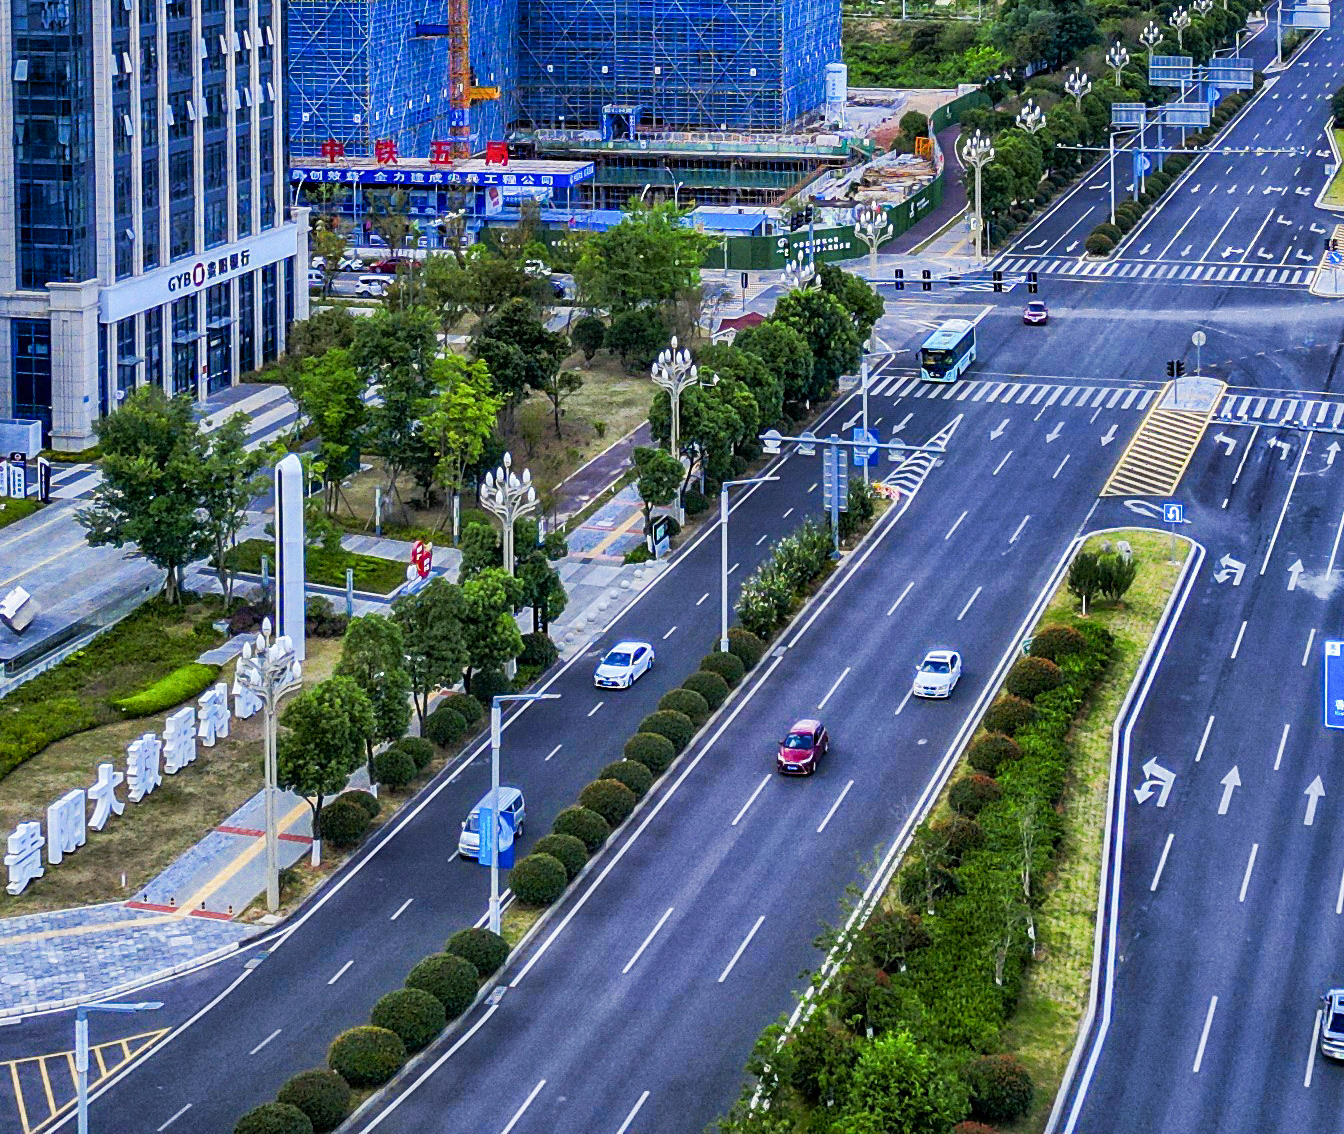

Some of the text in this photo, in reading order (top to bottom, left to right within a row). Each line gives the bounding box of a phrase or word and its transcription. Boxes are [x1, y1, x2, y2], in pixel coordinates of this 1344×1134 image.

[322, 138, 508, 166] 中铁五局
[168, 271, 191, 292] GYB
